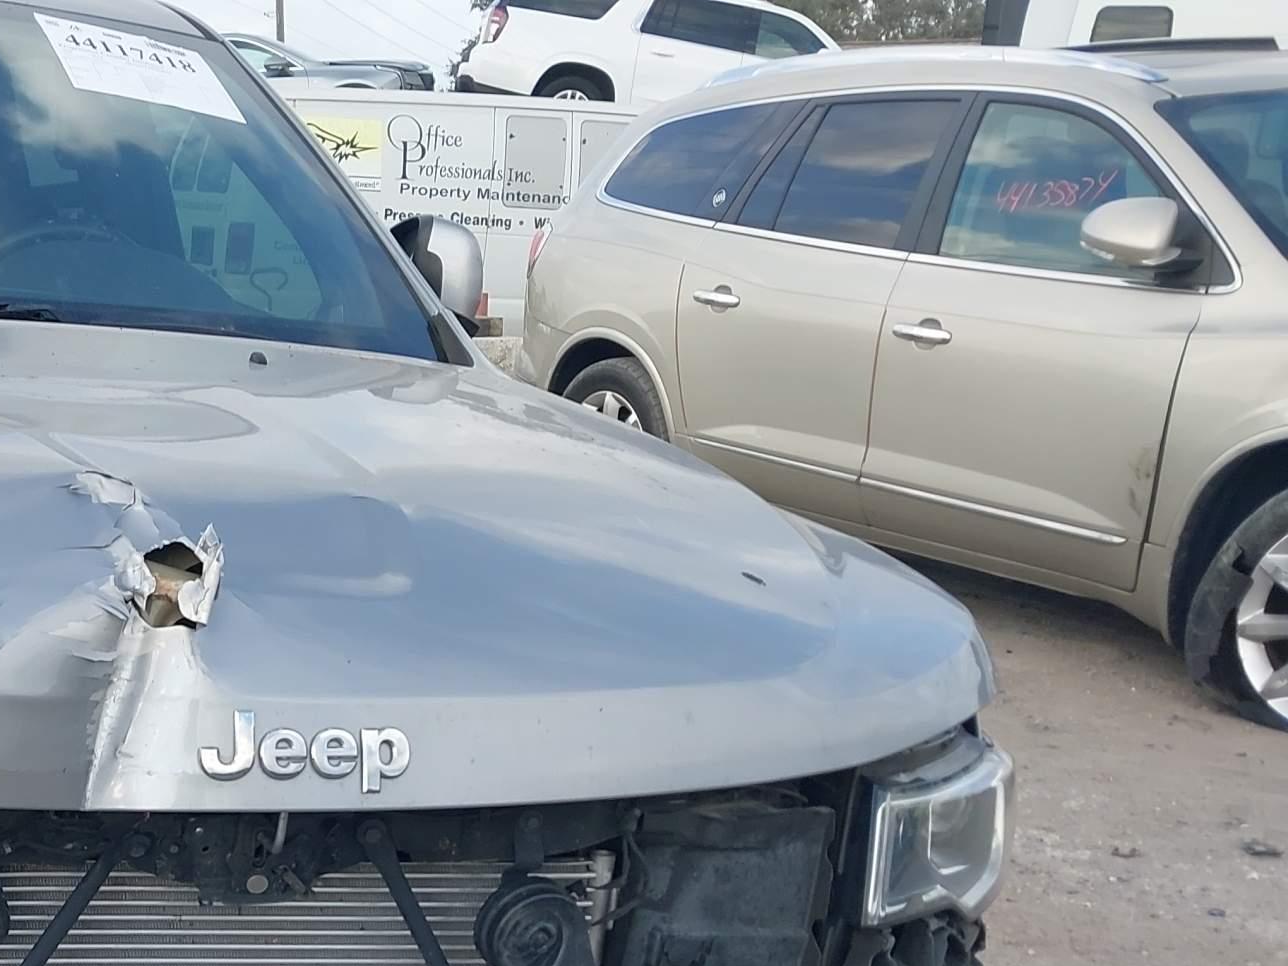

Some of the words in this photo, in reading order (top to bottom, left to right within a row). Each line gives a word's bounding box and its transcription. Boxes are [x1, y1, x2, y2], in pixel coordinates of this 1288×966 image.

[65, 33, 196, 73] 44117418
[387, 114, 463, 152] Office
[395, 140, 503, 184] Professionals
[508, 167, 536, 184] Inc.
[400, 183, 471, 202] Property
[996, 169, 1118, 213] 44135874
[450, 211, 512, 230] Cleaning
[198, 709, 410, 794] Jeep
